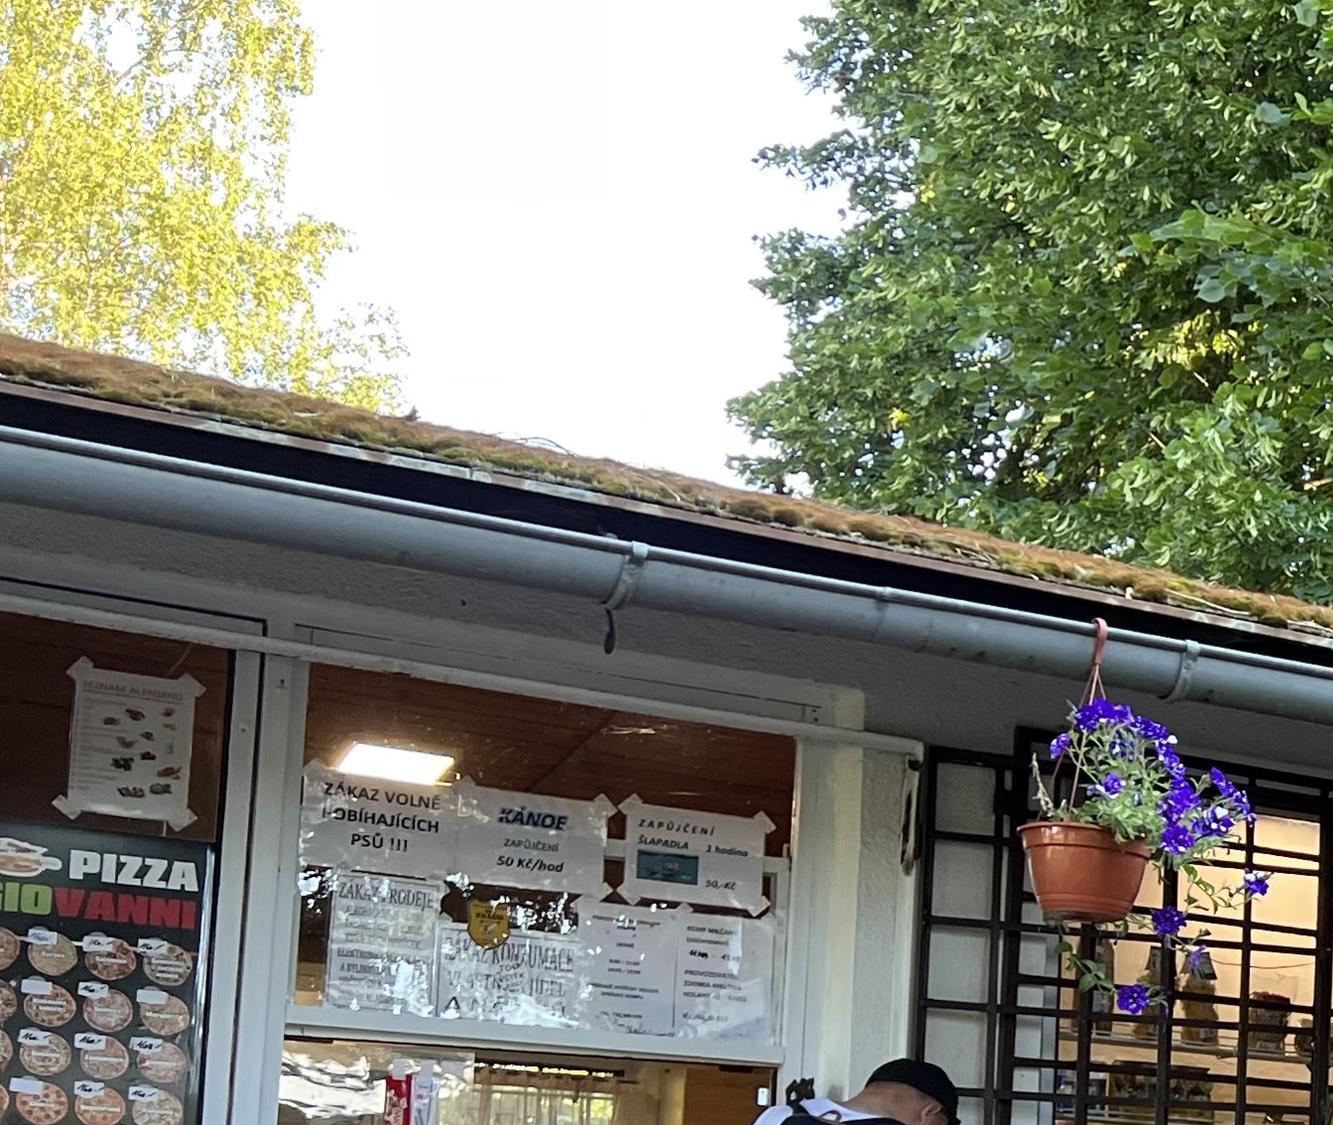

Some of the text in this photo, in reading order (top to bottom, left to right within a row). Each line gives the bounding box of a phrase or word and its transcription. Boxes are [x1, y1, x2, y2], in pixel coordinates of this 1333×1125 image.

[323, 781, 380, 802] ZÁKAZ
[497, 805, 569, 831] KÁNOE
[350, 832, 384, 849] PSŮ
[503, 838, 560, 853] ZAPŮJČENÍ
[637, 833, 689, 850] ŠLAPADLA
[714, 845, 749, 857] hodina
[68, 849, 199, 892] PIZZA
[496, 855, 565, 873] 50 Kč/hod
[0, 881, 197, 930] IOVANNI
